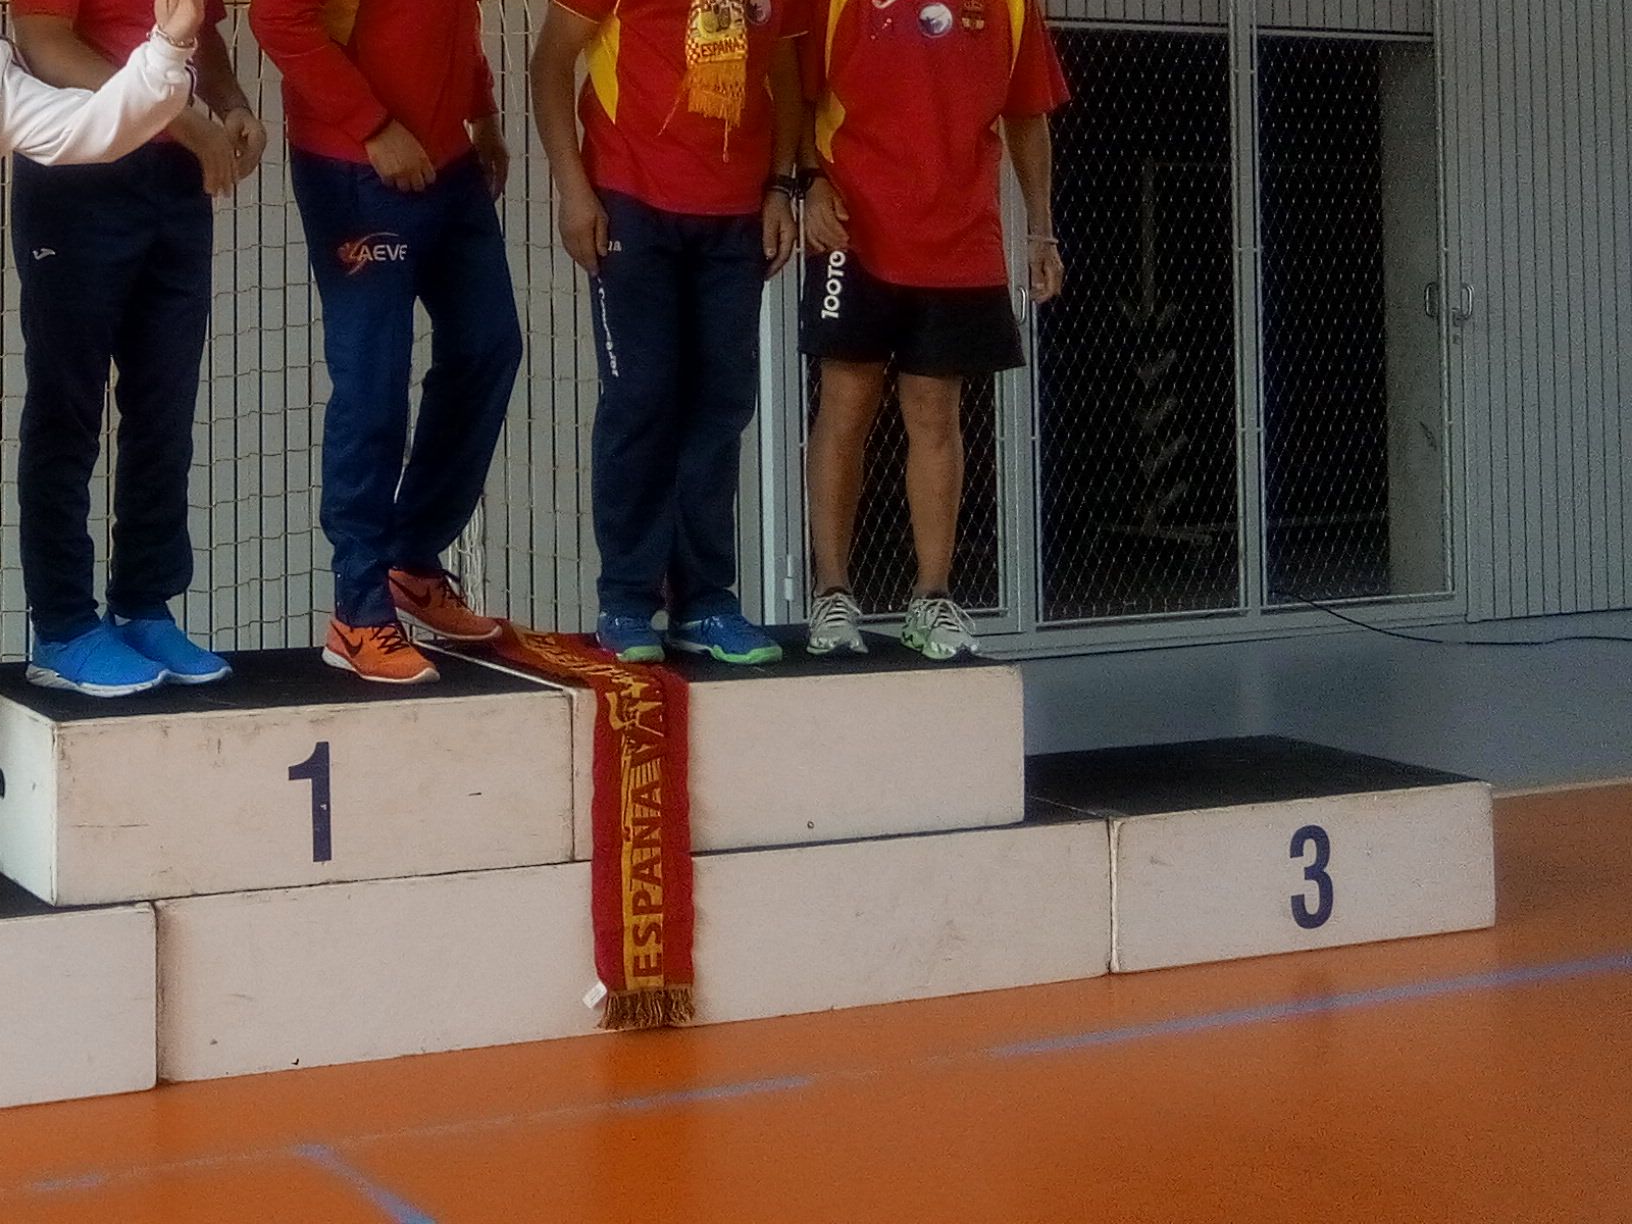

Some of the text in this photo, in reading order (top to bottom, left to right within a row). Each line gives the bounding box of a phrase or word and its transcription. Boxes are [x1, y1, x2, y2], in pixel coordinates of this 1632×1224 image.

[288, 741, 332, 862] 1
[624, 779, 665, 979] ESPAÑA
[1289, 824, 1334, 930] 3
